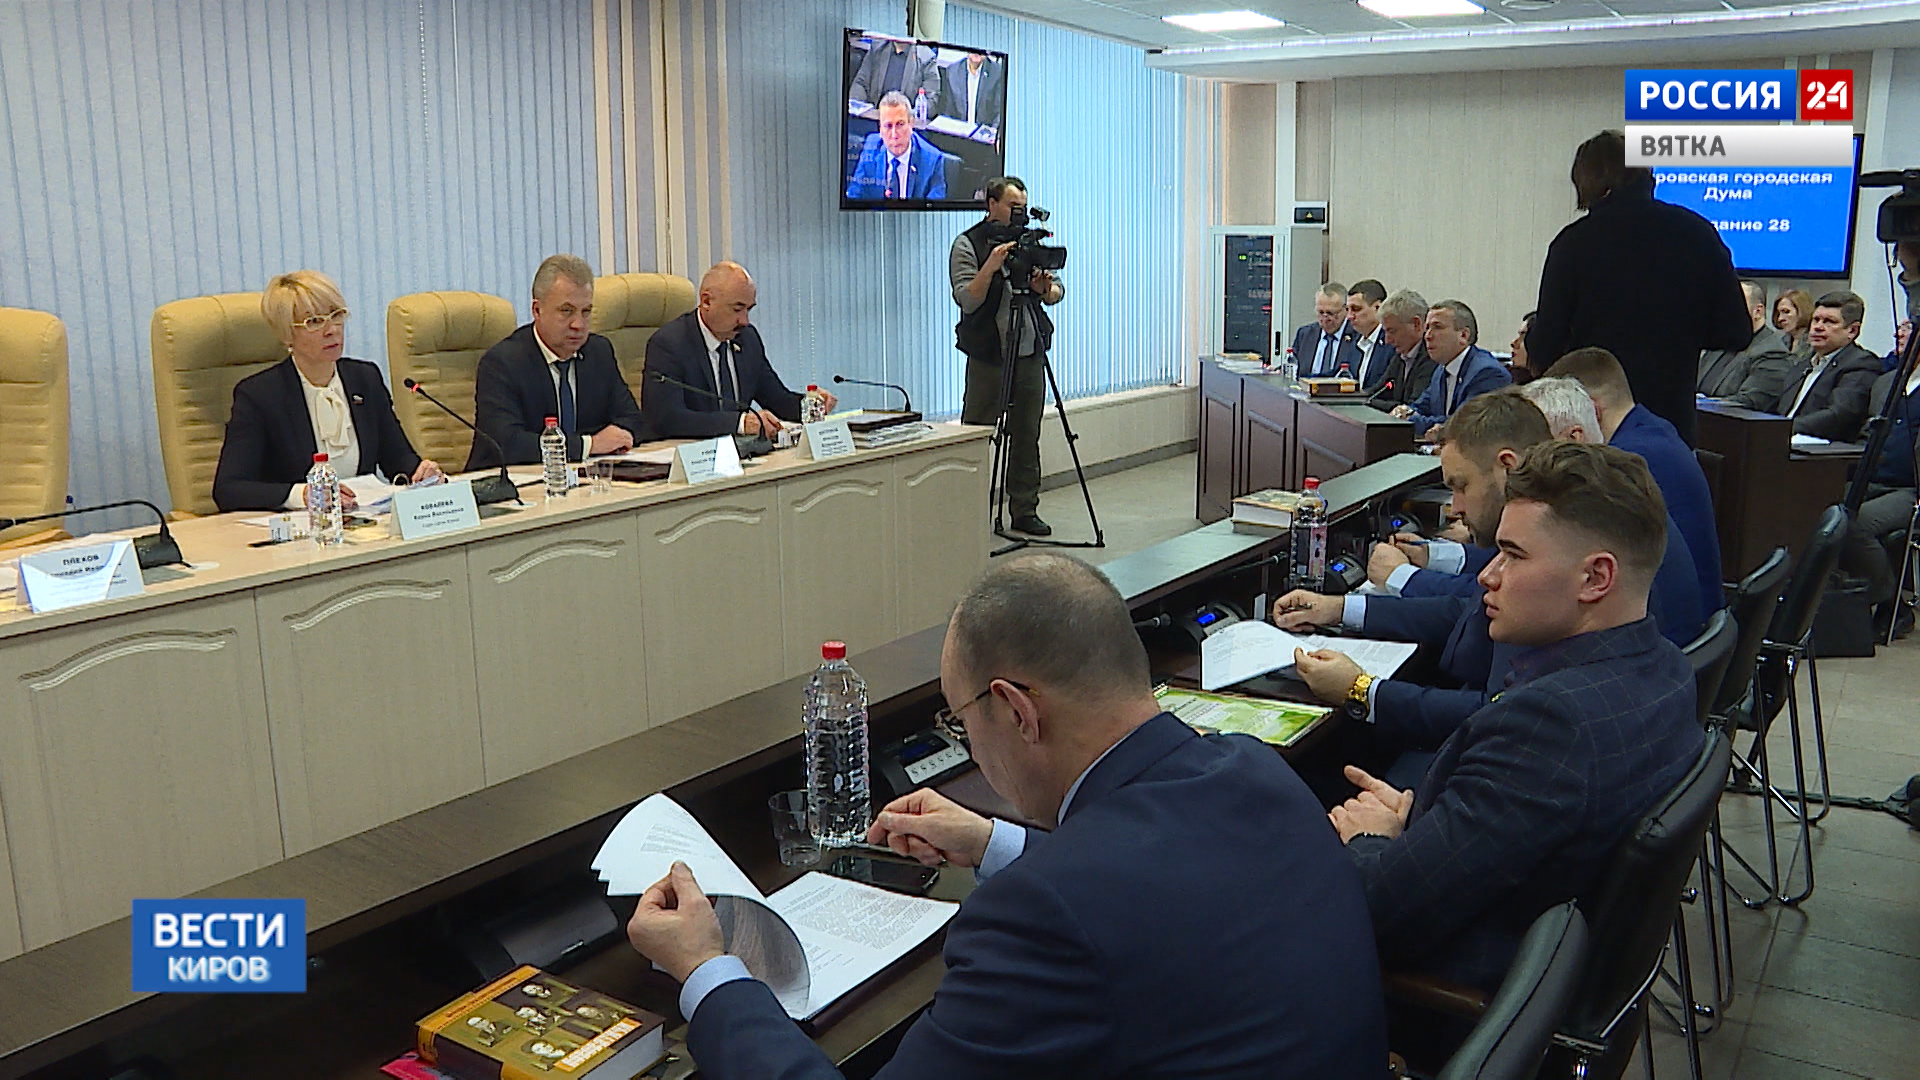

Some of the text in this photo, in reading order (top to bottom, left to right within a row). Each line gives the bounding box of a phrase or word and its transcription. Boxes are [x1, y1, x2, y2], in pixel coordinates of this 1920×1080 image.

[1653, 172, 1833, 187] ровская городская
[1703, 186, 1753, 202] Дума
[1767, 218, 1791, 232] 28
